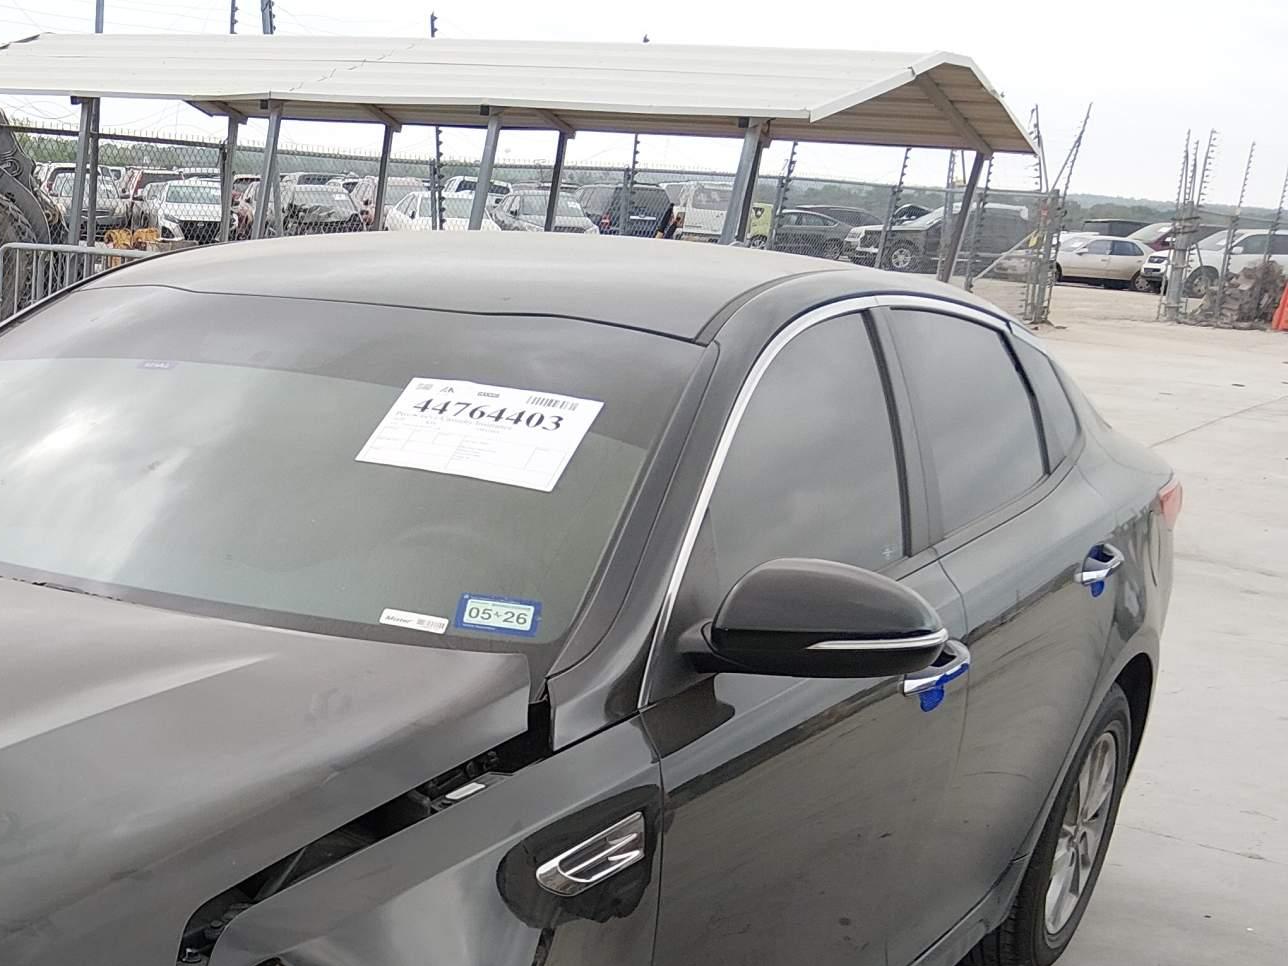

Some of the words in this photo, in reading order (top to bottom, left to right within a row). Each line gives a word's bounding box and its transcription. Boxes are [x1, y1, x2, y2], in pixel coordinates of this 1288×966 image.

[413, 398, 564, 431] 44764403
[468, 606, 492, 621] 05
[502, 610, 529, 626] 26
